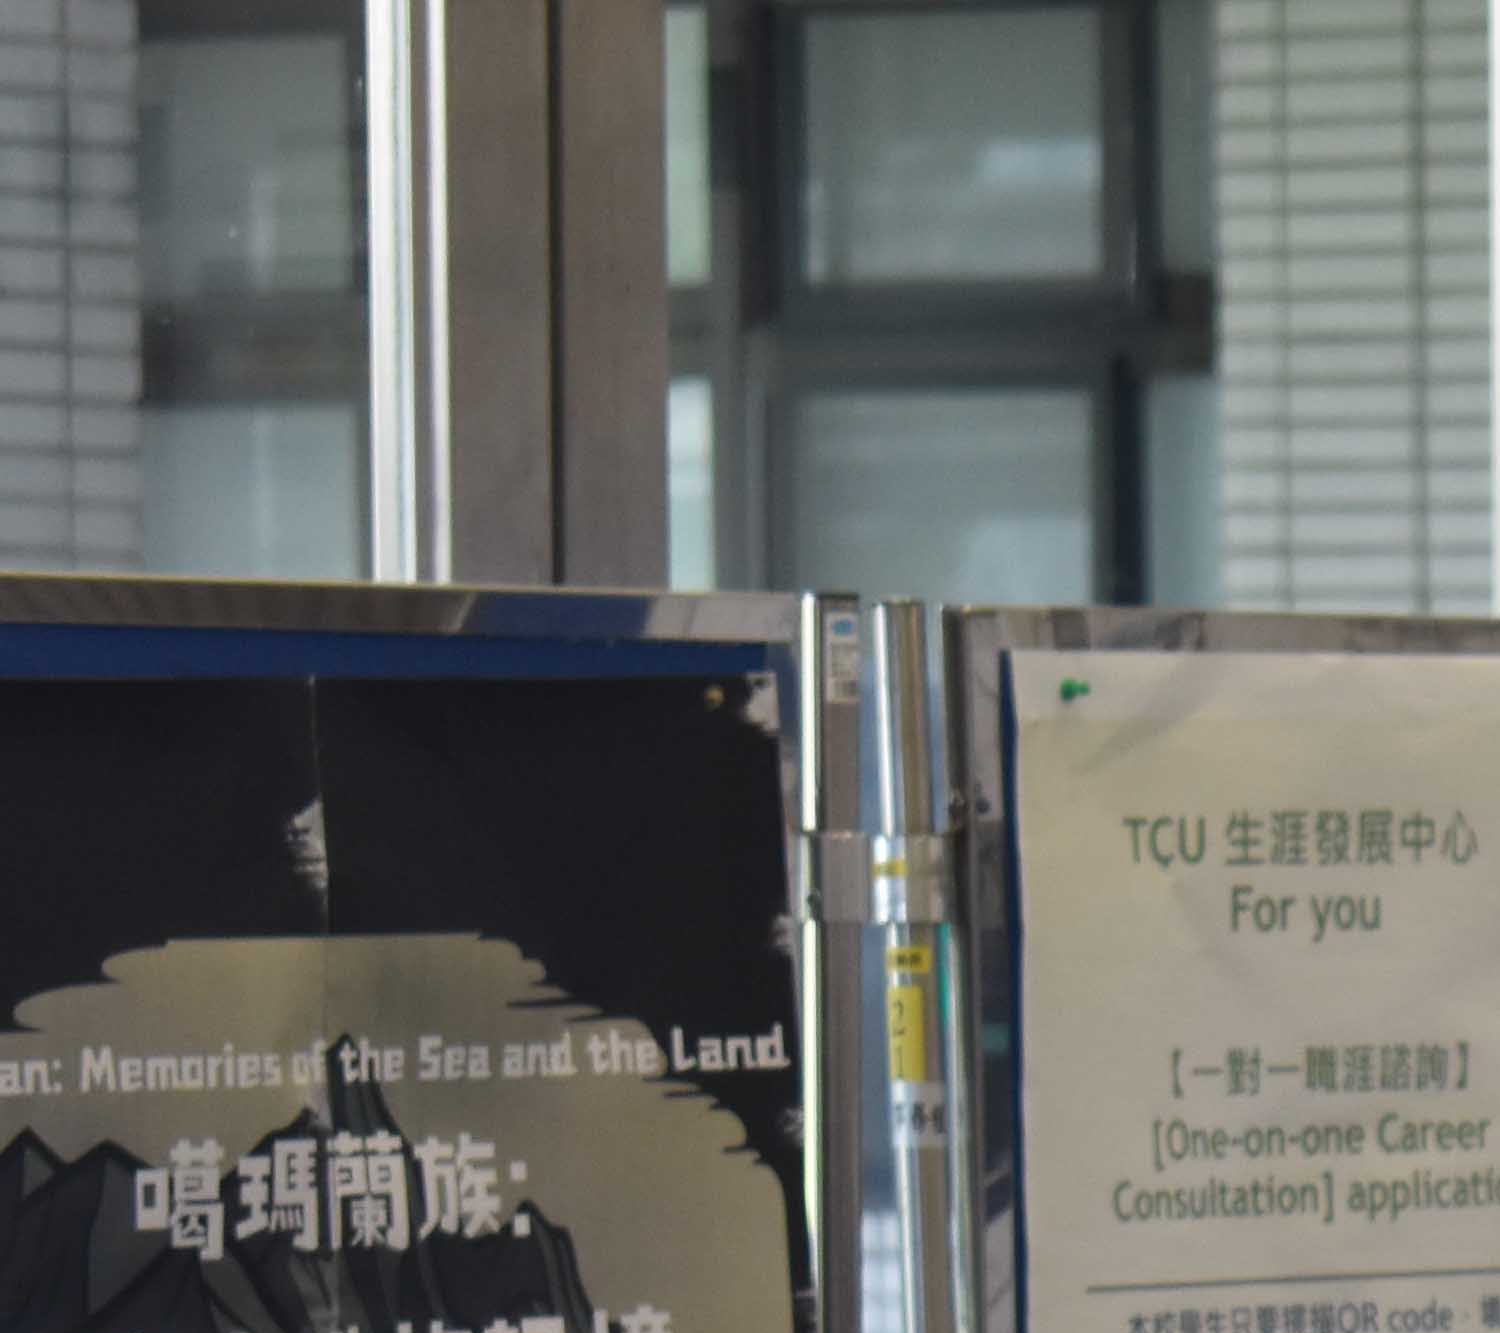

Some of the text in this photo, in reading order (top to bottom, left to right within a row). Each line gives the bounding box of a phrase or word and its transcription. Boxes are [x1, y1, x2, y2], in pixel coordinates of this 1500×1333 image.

[1122, 809, 1480, 870] TCU 生涯發展中心
[1230, 887, 1382, 943] For you
[80, 1041, 284, 1096] Memories
[290, 1038, 327, 1085] of
[338, 1034, 405, 1084] the
[417, 1033, 491, 1081] Sea
[502, 1029, 578, 1077] and
[587, 1028, 663, 1075] the
[670, 1022, 791, 1072] Land
[1152, 1111, 1491, 1171] [One-on-one Career
[1112, 1178, 1336, 1226] Consultation]
